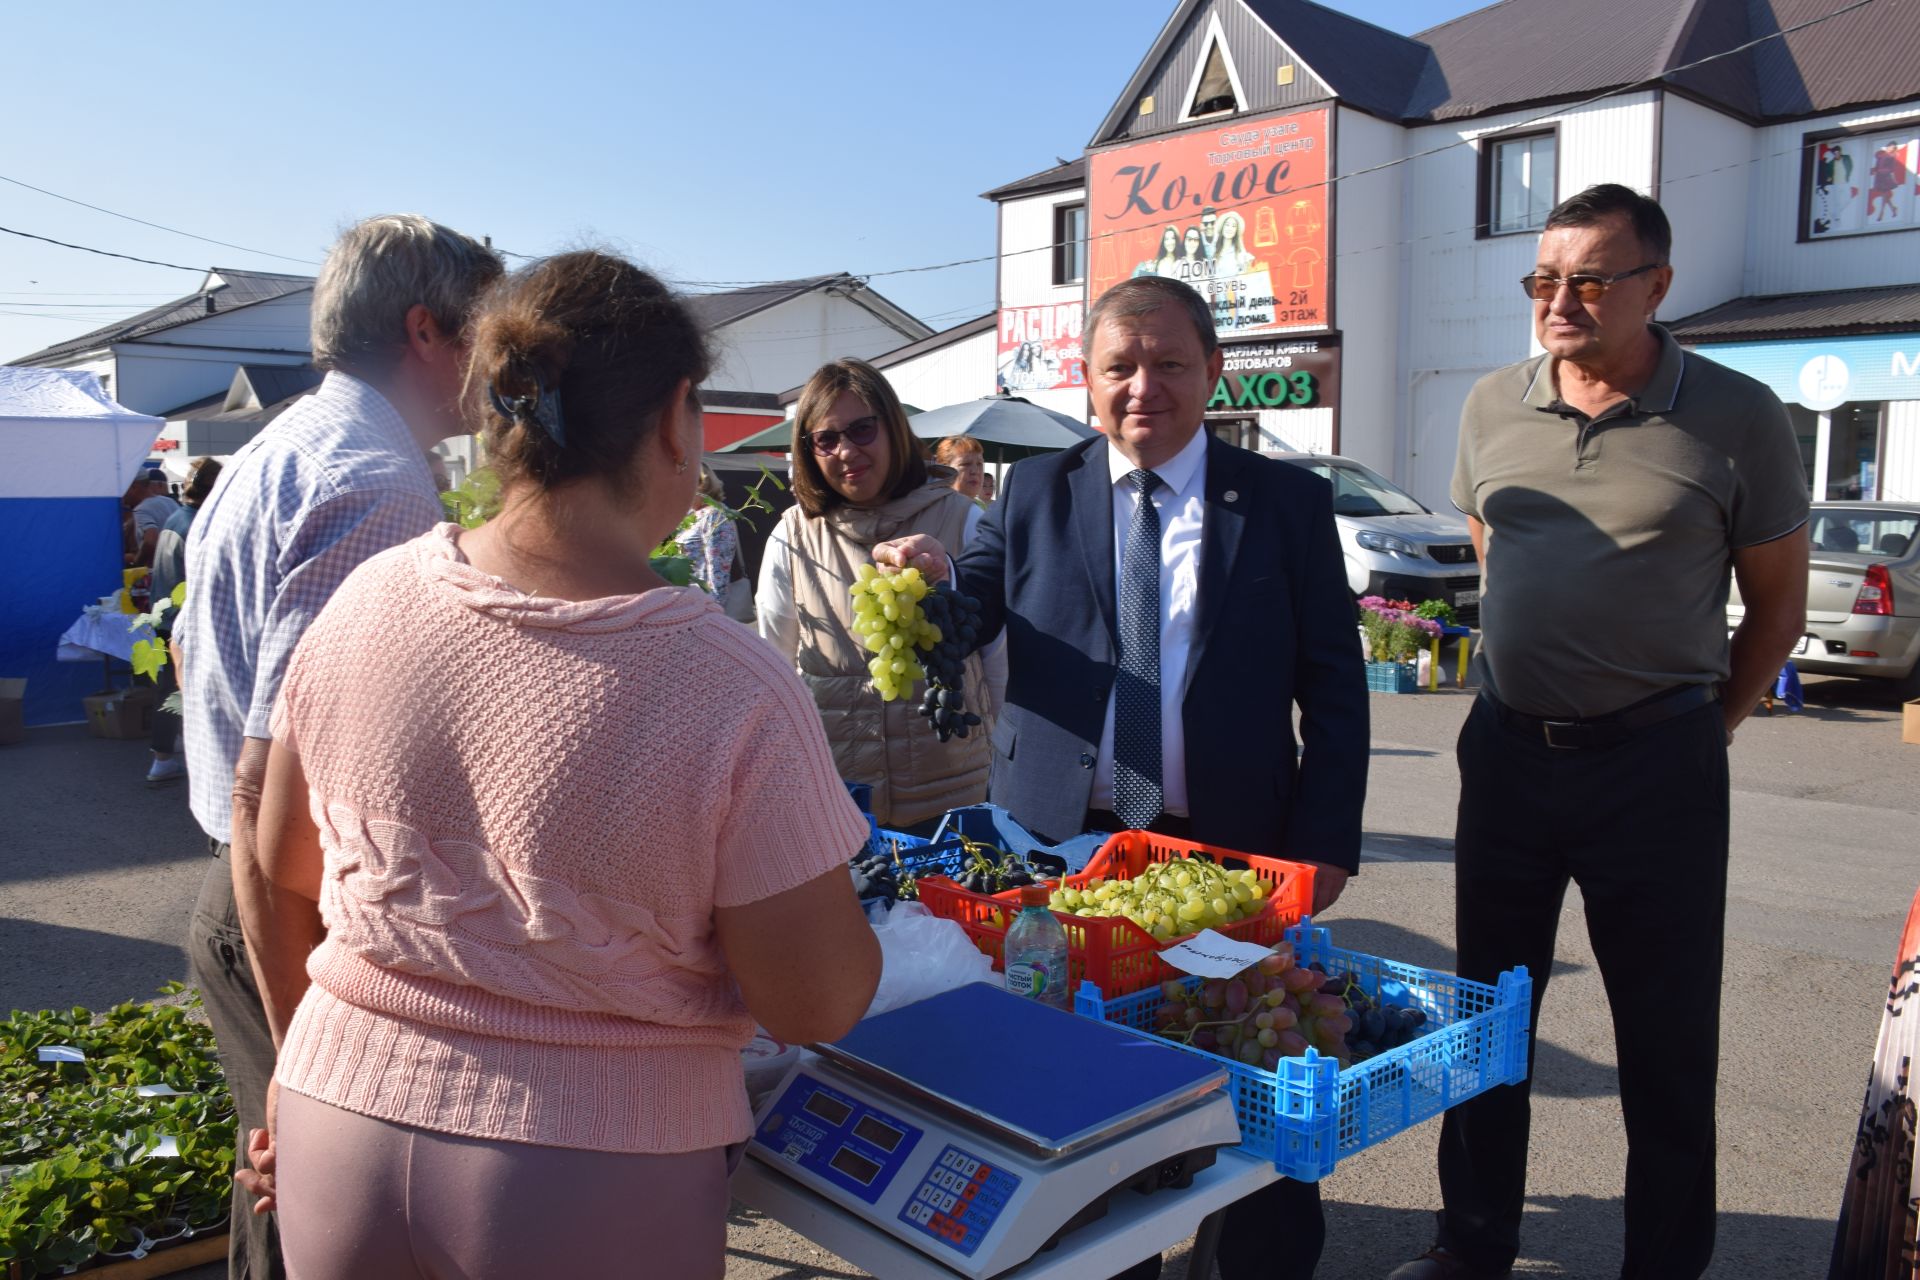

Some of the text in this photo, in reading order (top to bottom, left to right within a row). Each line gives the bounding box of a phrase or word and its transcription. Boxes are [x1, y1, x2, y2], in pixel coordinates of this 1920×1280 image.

[1208, 136, 1315, 167] Торговый центр
[1104, 159, 1292, 220] Колос
[1280, 308, 1318, 322] этаж
[1289, 290, 1309, 306] 2й
[1001, 303, 1082, 344] РАСПРО
[1207, 370, 1313, 407] АХОЗ
